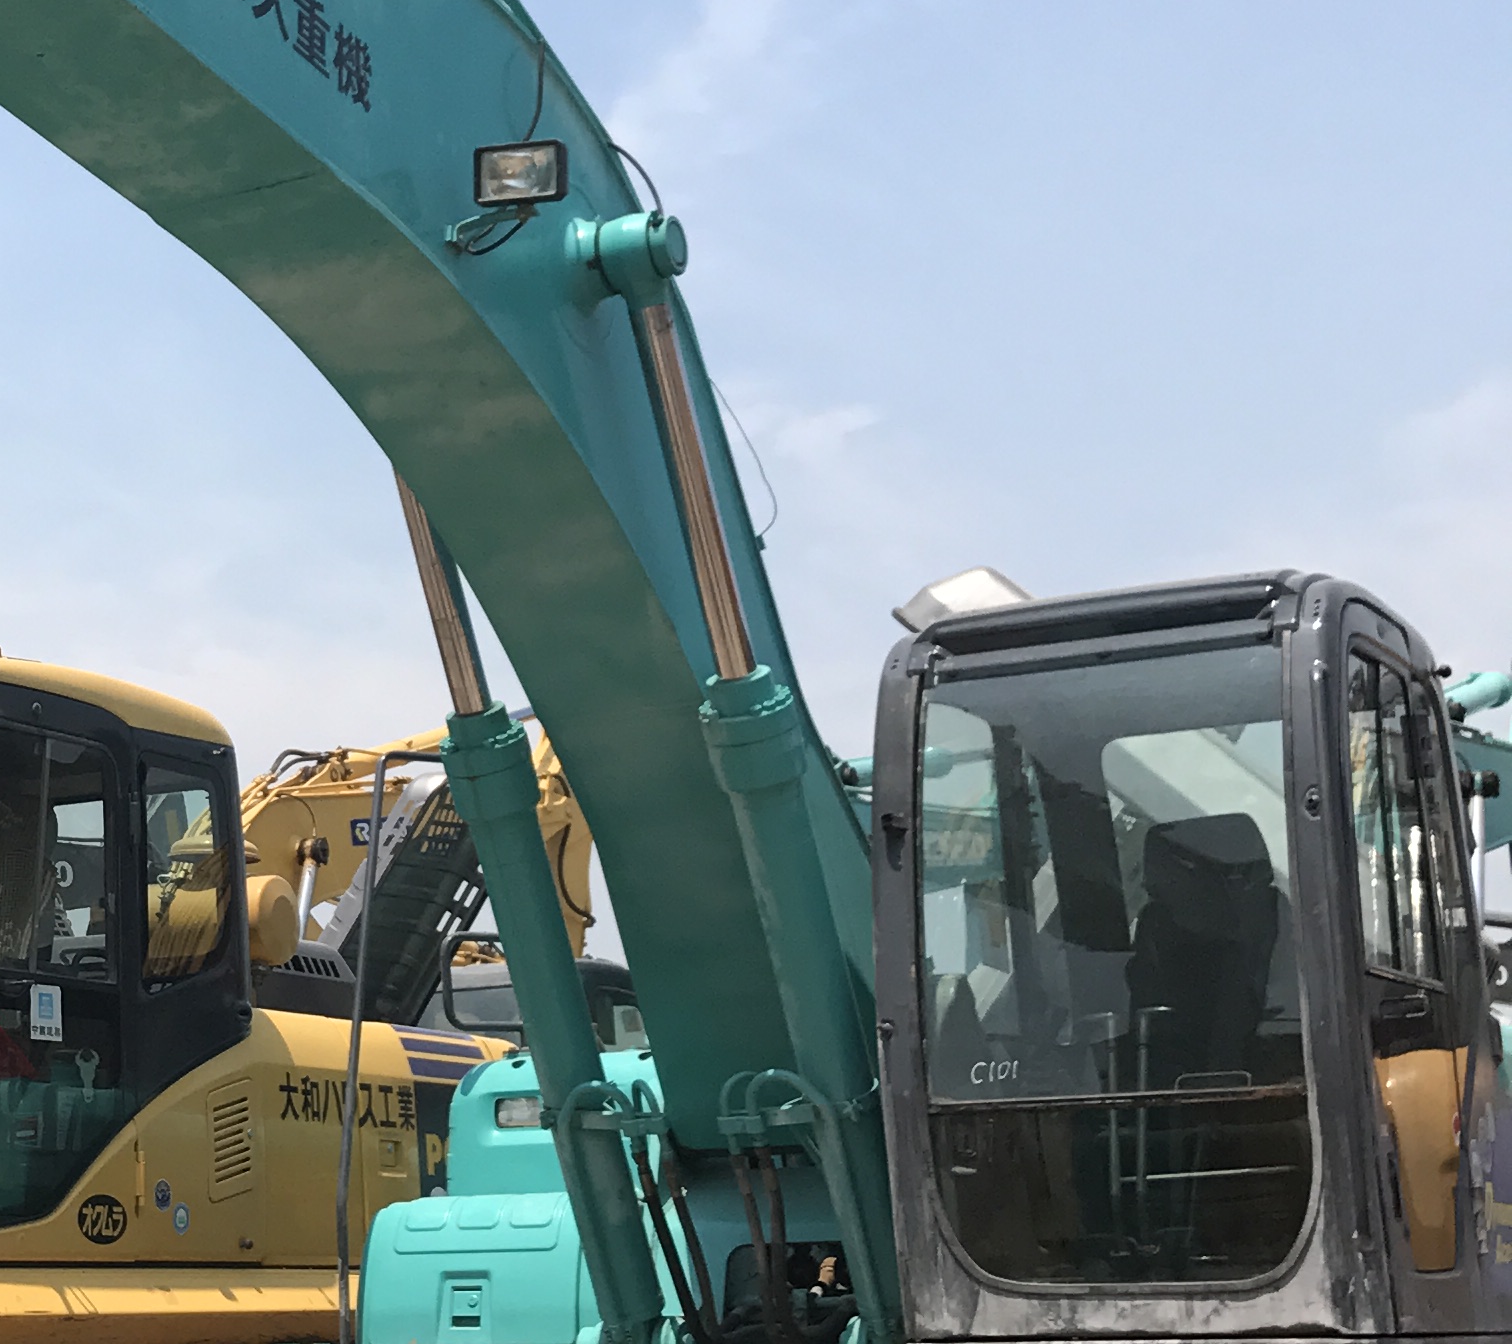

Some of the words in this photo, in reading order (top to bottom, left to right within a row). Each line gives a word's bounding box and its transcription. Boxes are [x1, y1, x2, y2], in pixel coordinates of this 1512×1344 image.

[278, 1072, 416, 1131] 大和ハス工業
[82, 1203, 124, 1237] オクムラ
